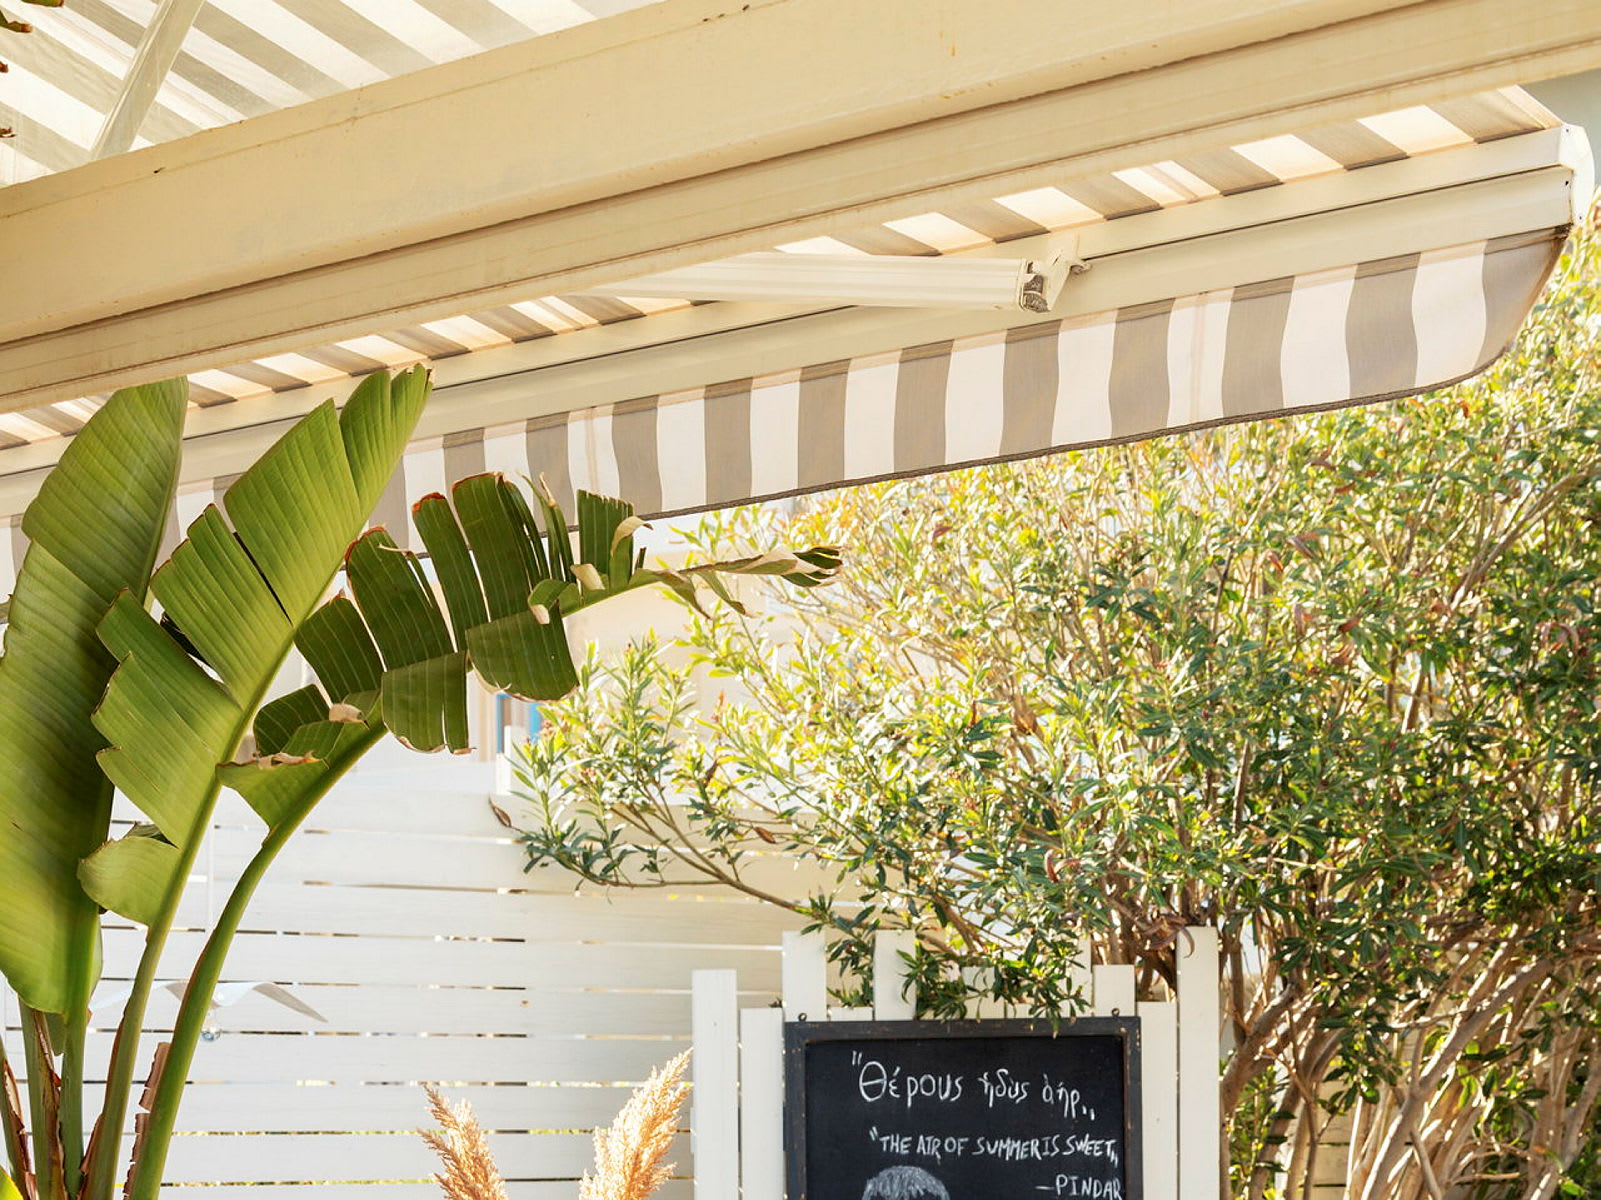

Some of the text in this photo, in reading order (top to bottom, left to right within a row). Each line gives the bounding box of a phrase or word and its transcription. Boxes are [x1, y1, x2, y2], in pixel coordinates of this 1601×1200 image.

[916, 1134, 942, 1165] AIR
[944, 1136, 972, 1157] OF
[972, 1136, 1041, 1161] SUMMER
[1042, 1136, 1060, 1158] IS
